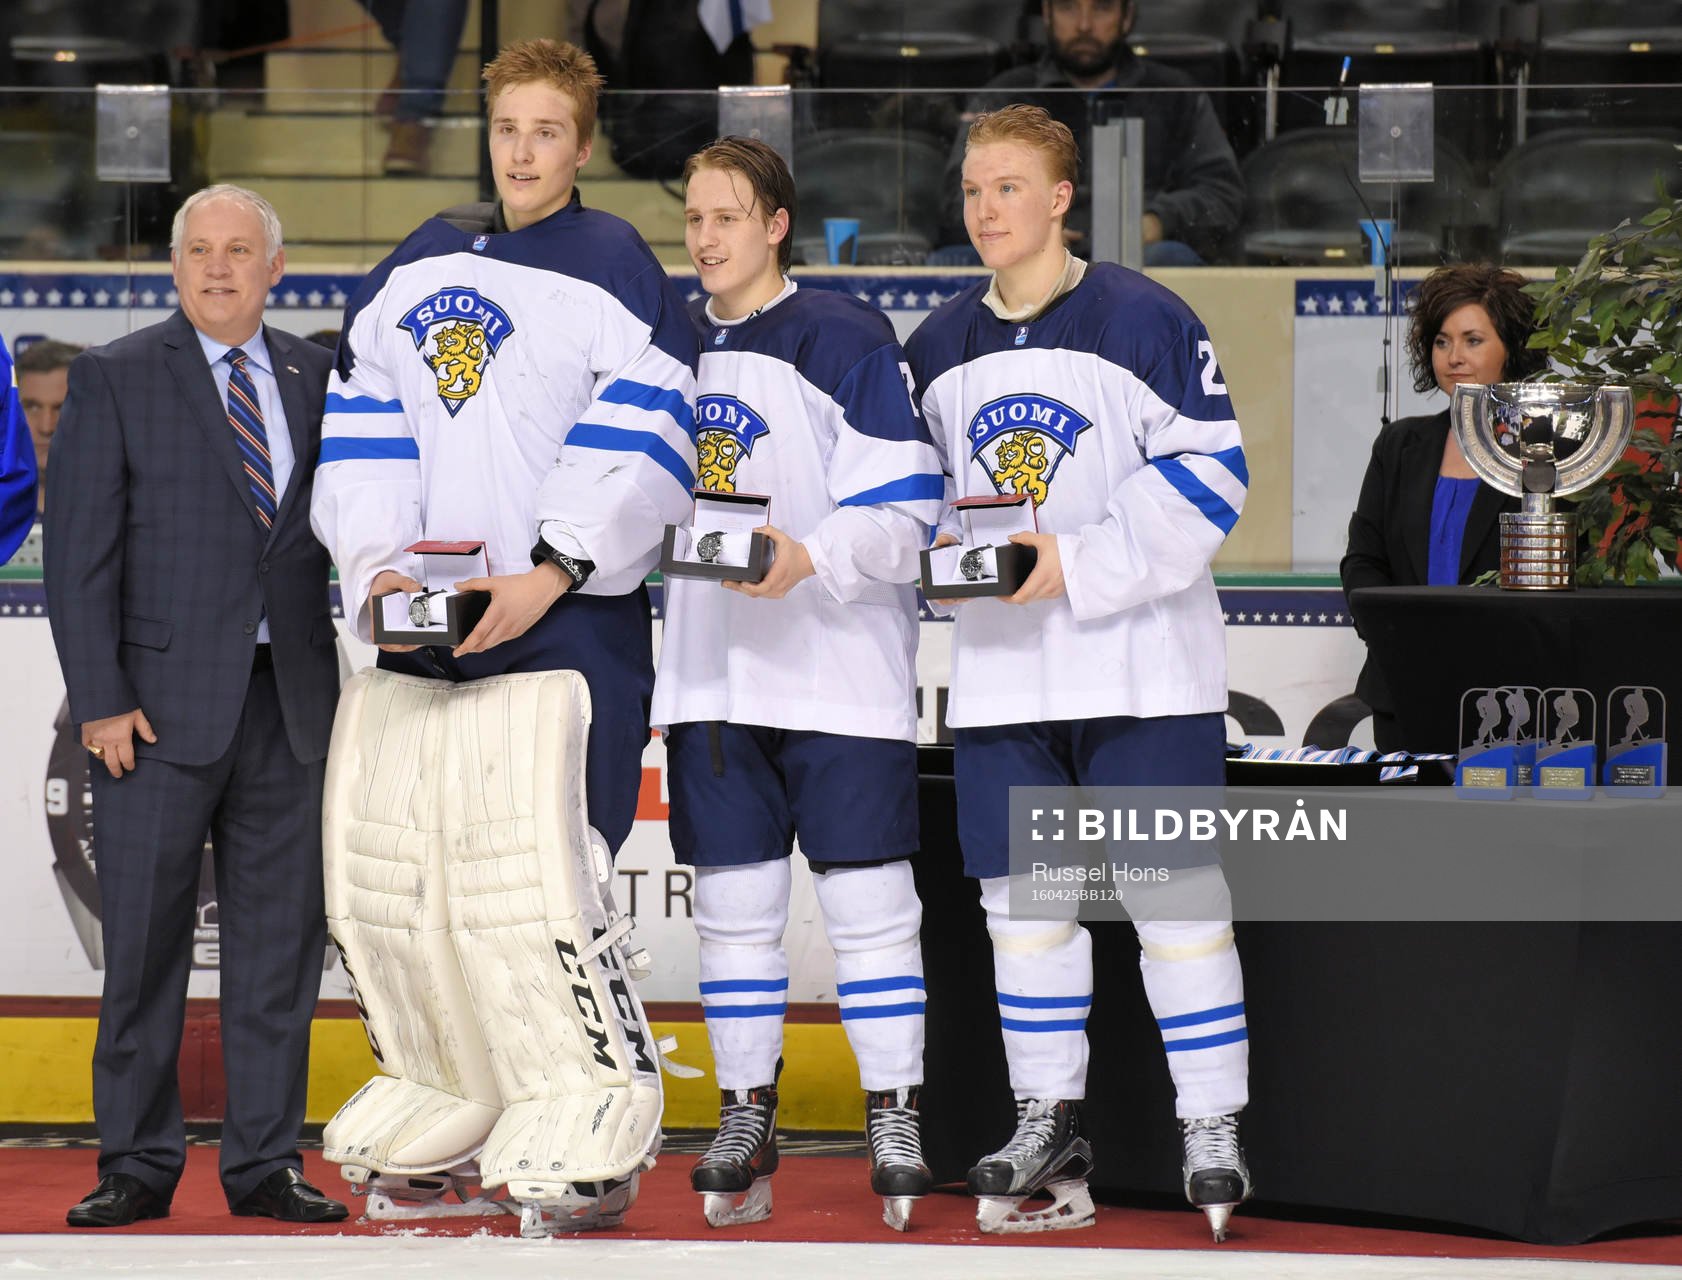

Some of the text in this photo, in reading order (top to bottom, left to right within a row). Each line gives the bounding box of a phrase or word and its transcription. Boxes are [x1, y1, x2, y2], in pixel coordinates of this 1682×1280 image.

[416, 295, 503, 337] SUOMI
[975, 402, 1070, 440] SUOMI
[555, 937, 618, 1071] CCM
